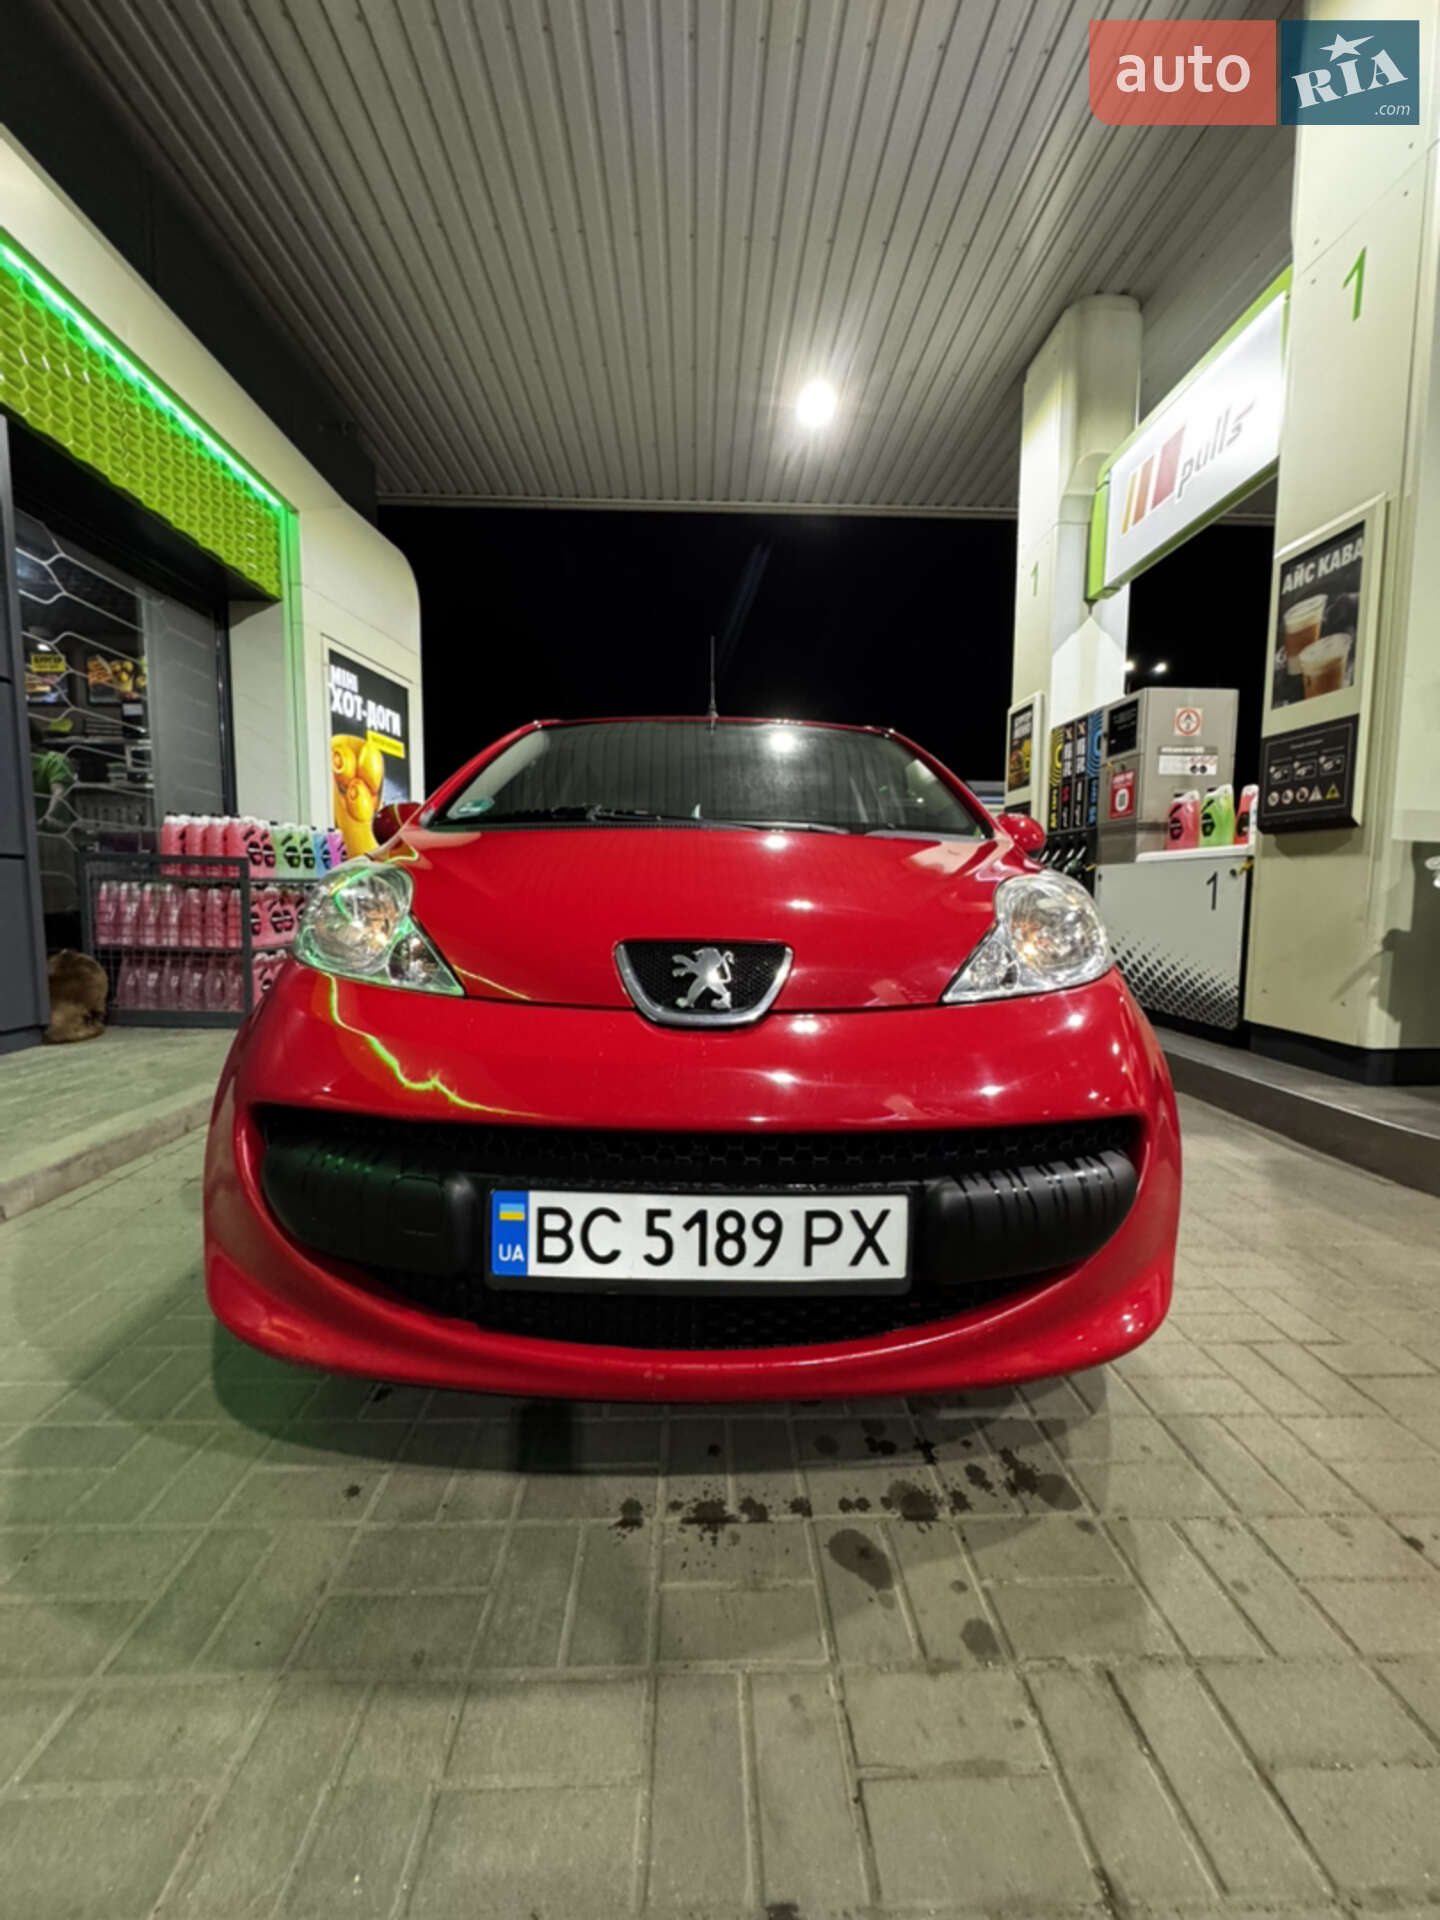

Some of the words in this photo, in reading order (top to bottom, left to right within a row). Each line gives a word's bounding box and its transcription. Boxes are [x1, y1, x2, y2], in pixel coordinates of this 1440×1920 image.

[1341, 245, 1367, 322] 1
[1175, 398, 1257, 500] pulls
[1281, 561, 1315, 595] АЙС
[1316, 537, 1364, 579] КАВА
[328, 682, 402, 737] ХОТ-ДОГИ
[1206, 870, 1219, 911] 1
[498, 1243, 525, 1263] UA
[536, 1206, 622, 1265] BC
[643, 1208, 783, 1267] 5189
[803, 1208, 891, 1267] PX
